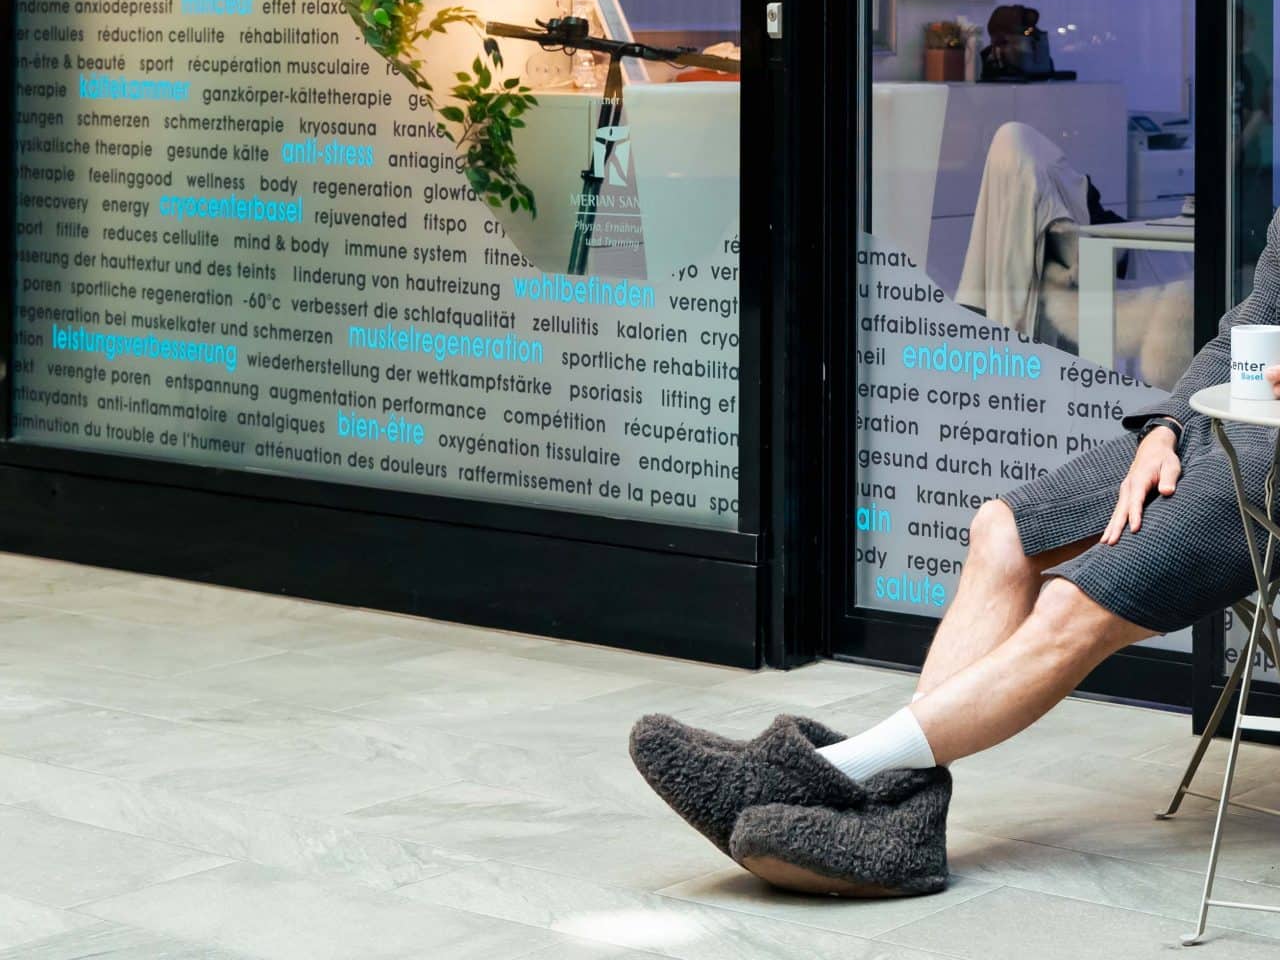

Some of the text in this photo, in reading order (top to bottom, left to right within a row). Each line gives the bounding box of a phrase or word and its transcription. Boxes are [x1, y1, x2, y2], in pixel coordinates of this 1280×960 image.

[189, 58, 369, 75] récupération musculaire
[80, 74, 391, 108] kältekammer ganzkörper-kältetherapie
[165, 115, 376, 137] schmerztherapie kryosauna
[281, 139, 465, 173] anti-stress antiaging
[313, 181, 412, 199] regeneration
[160, 195, 406, 228] cryocenterbasel rejuvenated
[345, 240, 407, 259] immune
[294, 266, 654, 307] linderung hautreizung wohlbefinden
[877, 281, 944, 303] trouble
[142, 288, 686, 343] regeneration verbessert schlafqualität zellulitis kalorien
[861, 313, 1010, 344] affaiblissement
[132, 315, 646, 372] muskelkater schmerzen muskelregeneration sportliche
[52, 325, 710, 415] leistungsverbesserung wiederherstellung wettkampfstärke psoriasis lifting
[902, 342, 1041, 380] endorphine
[1241, 373, 1264, 381] Basel
[166, 374, 739, 447] entspannung augmentation performance compétition récupération
[988, 393, 1046, 413] entier
[97, 396, 739, 480] anti-inflammatoire antalgiques bien-être oxygénation tissulaire endorphine
[940, 421, 1057, 449] préparation
[184, 432, 592, 495] l'humeur atténuation douleurs raffermissement
[859, 446, 991, 476] gesund durch
[876, 575, 945, 606] salute
